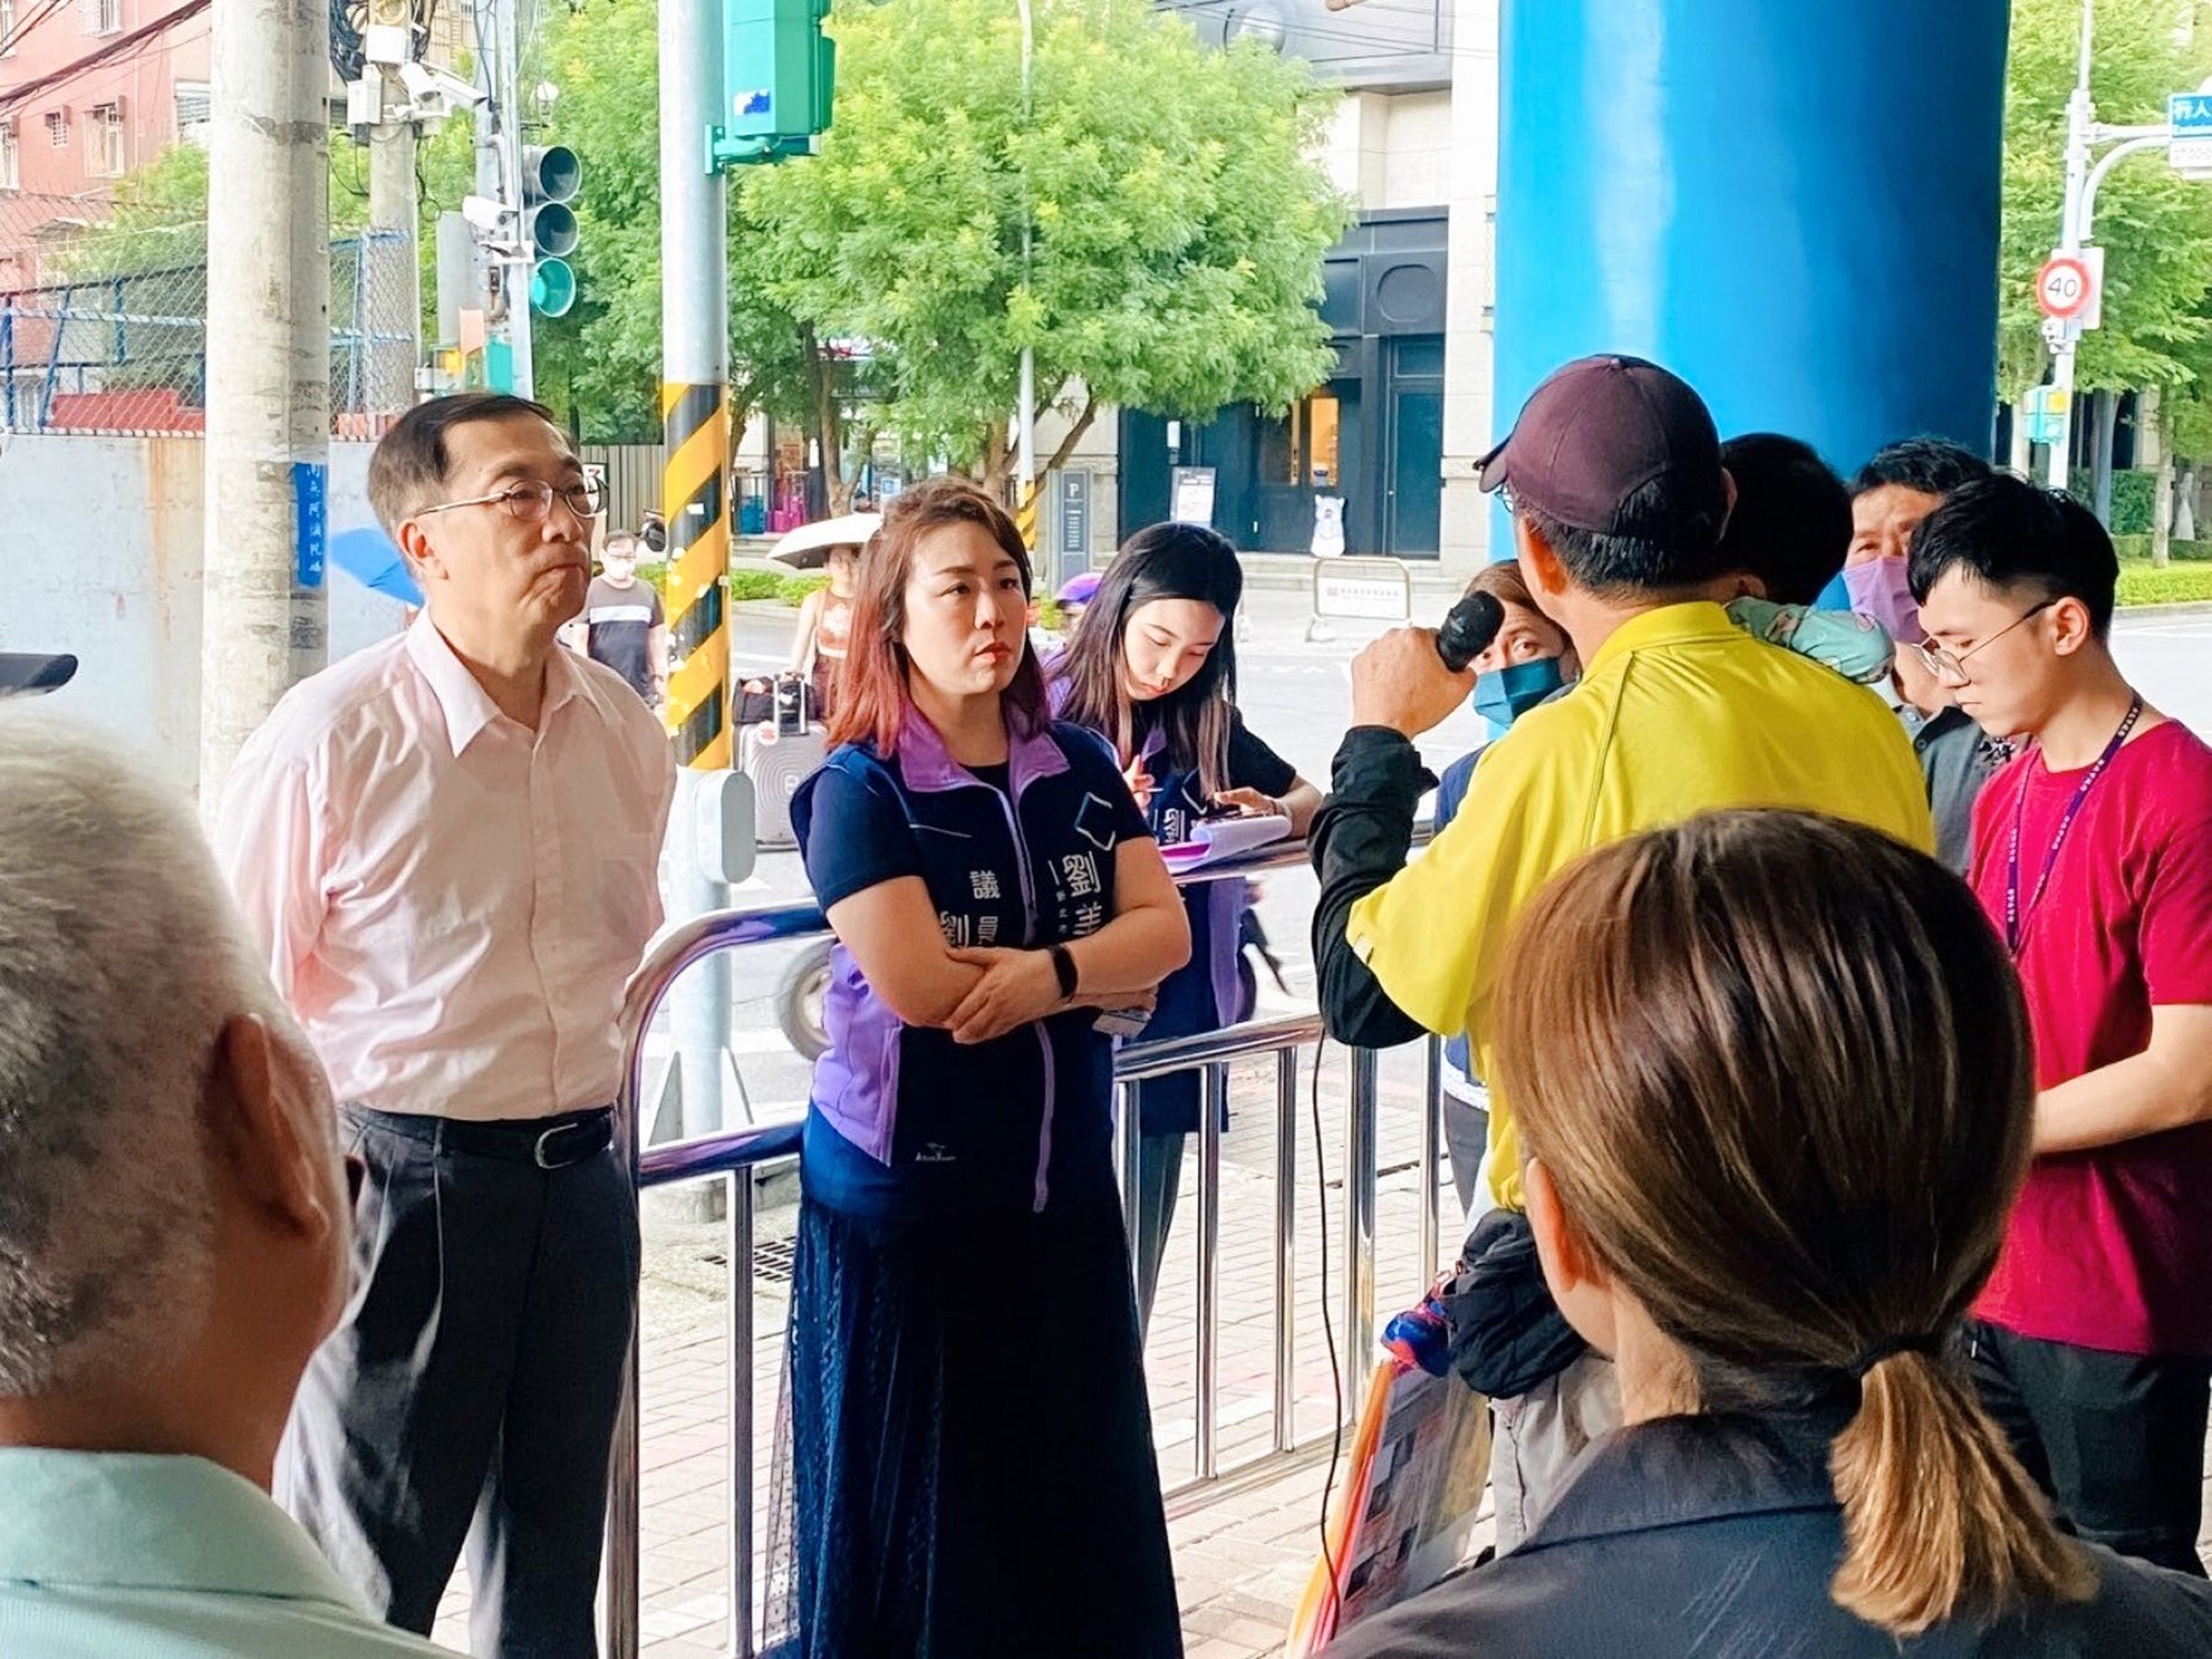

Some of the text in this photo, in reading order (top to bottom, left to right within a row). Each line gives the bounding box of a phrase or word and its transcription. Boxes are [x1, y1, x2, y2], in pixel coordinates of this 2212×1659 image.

[2048, 277, 2077, 298] 40
[1069, 482, 1079, 498] P
[969, 869, 1001, 945] 議員
